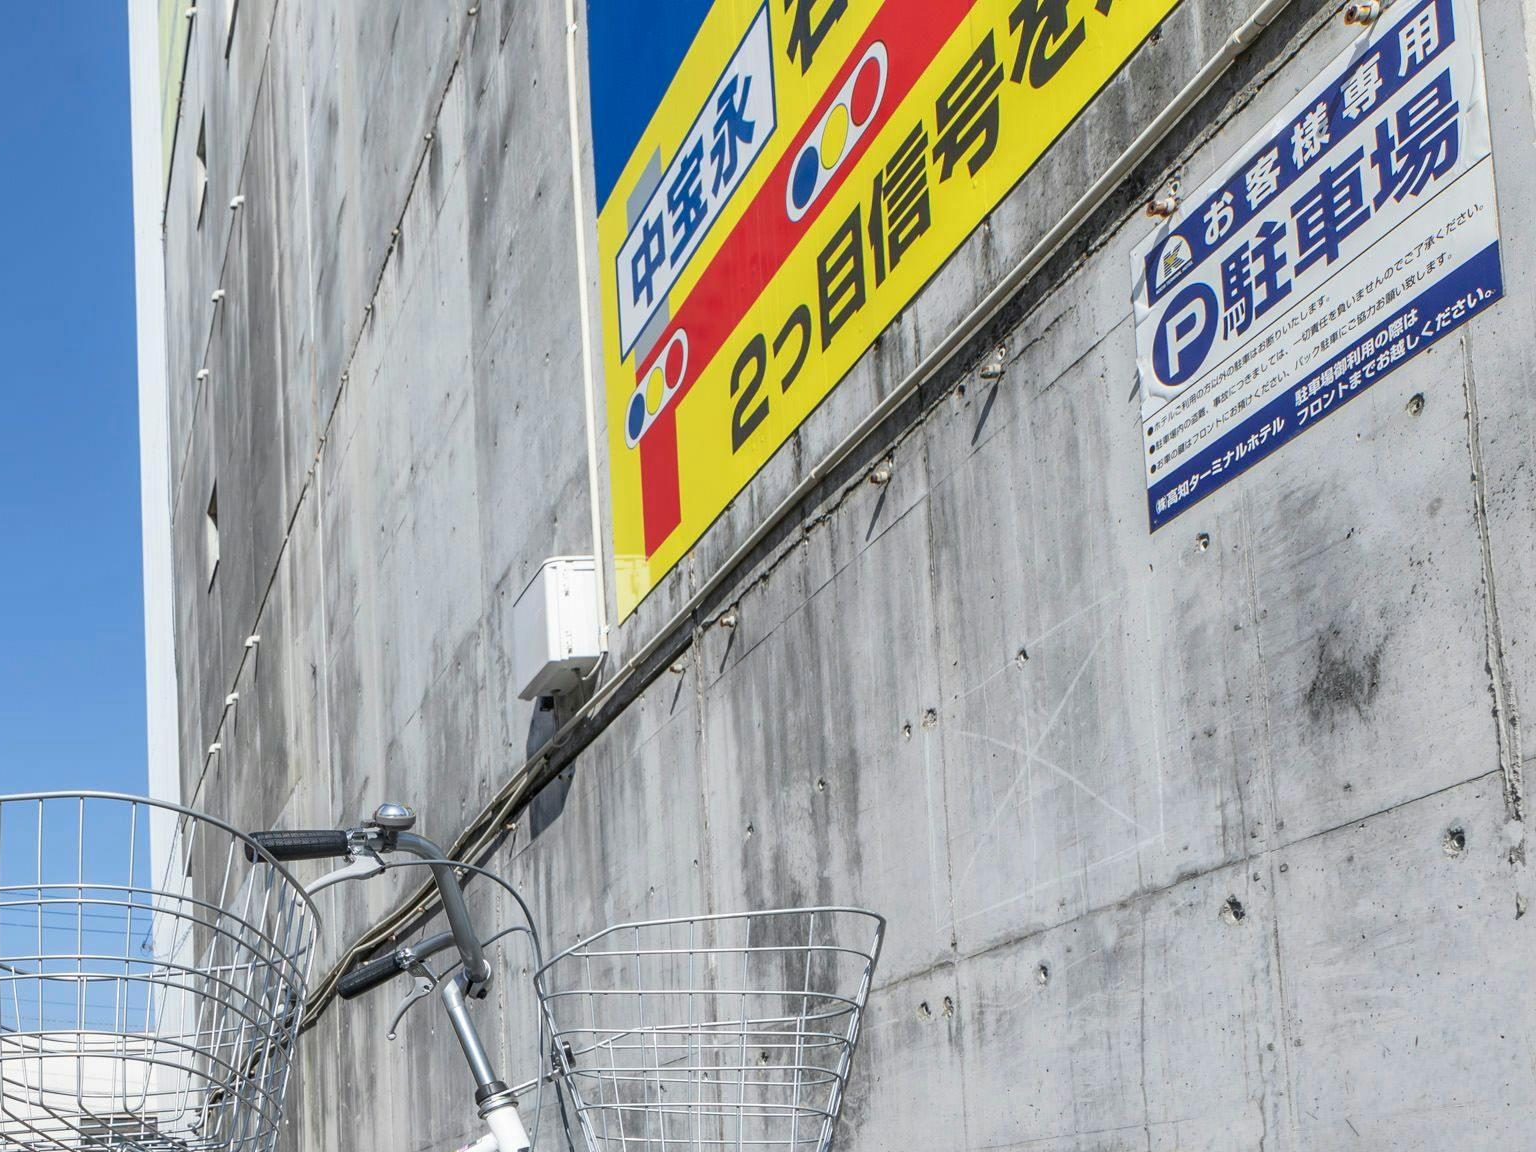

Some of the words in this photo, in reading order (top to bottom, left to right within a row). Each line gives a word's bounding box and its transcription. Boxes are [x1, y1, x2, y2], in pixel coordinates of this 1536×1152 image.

[631, 73, 755, 309] 中宝永
[730, 0, 1122, 455] 2つ目信号を
[1204, 1, 1439, 246] お客様専用
[1221, 66, 1460, 343] 駐車場
[1295, 308, 1419, 407] 駐車場御利用の際は
[1297, 287, 1495, 426] フロントまでお越しください。
